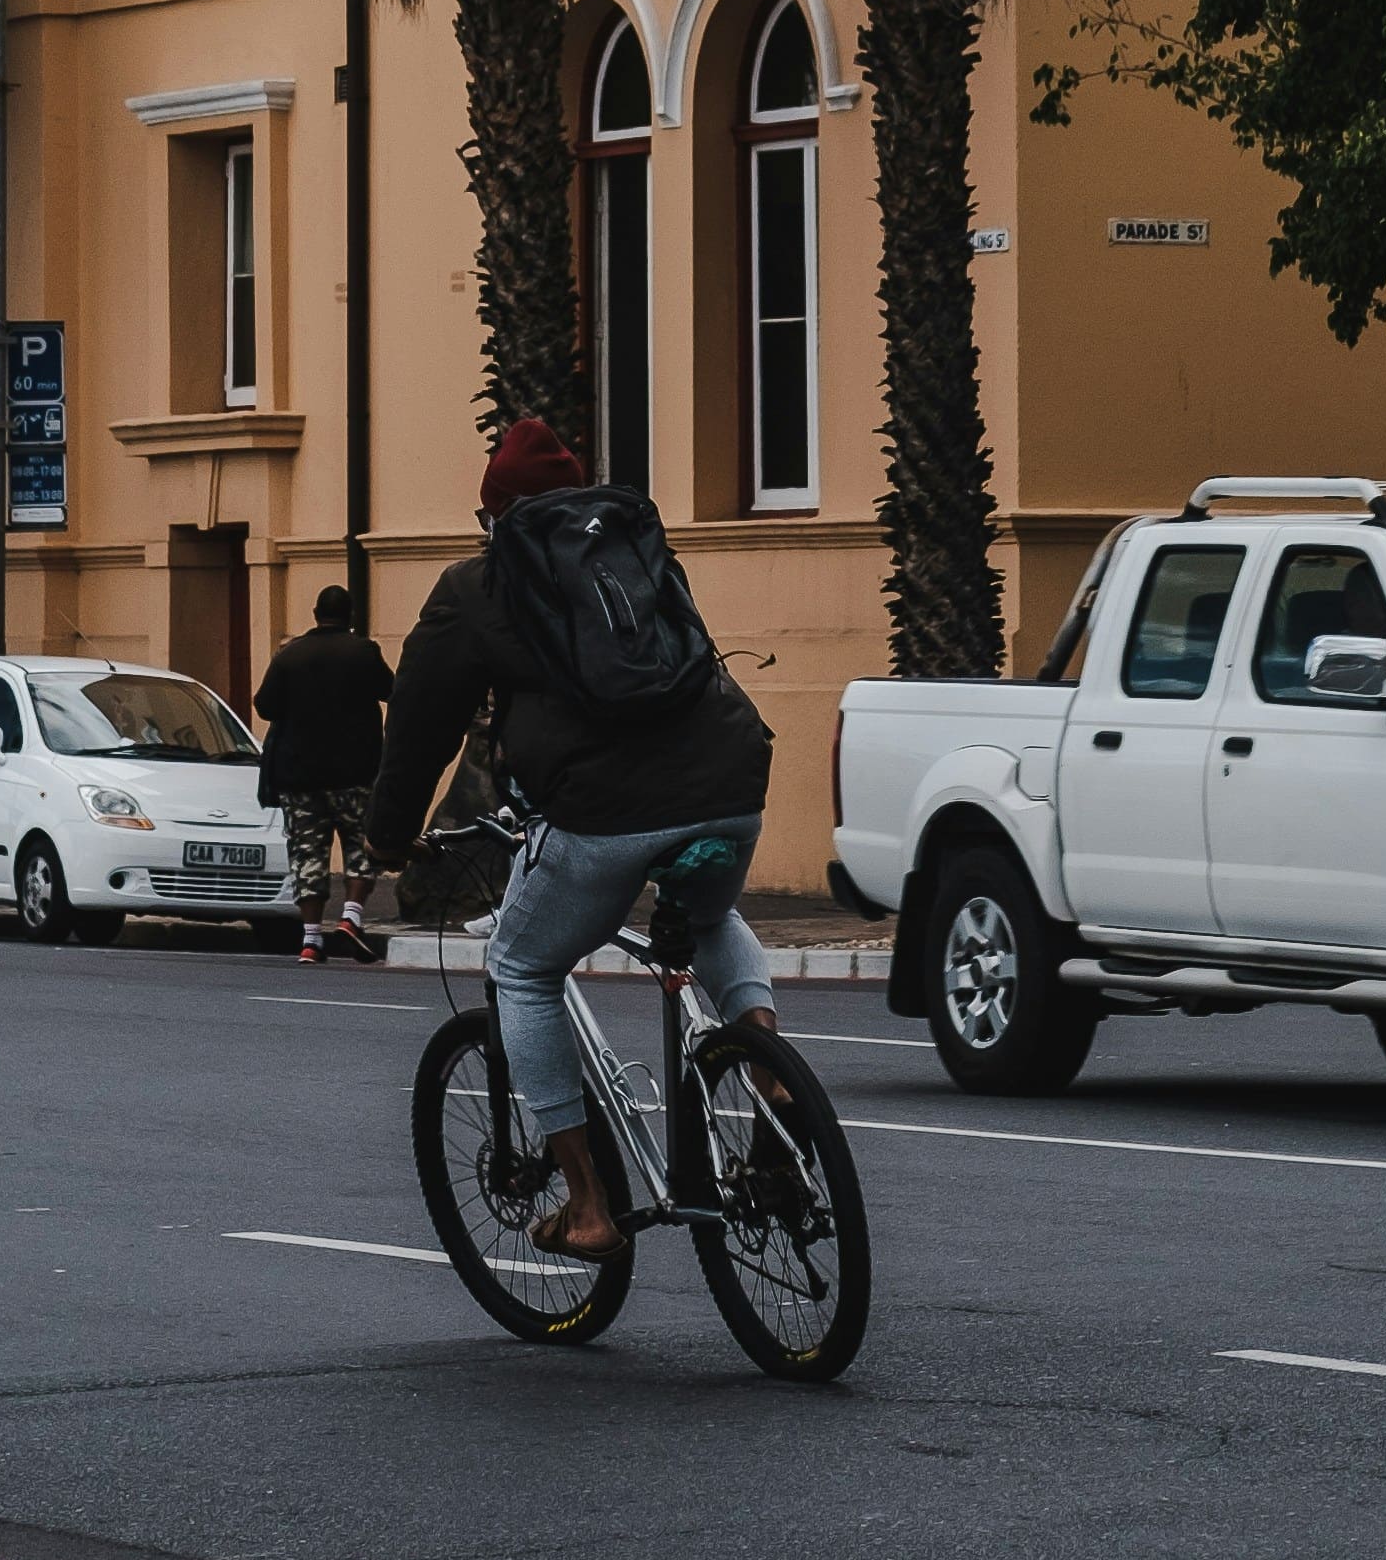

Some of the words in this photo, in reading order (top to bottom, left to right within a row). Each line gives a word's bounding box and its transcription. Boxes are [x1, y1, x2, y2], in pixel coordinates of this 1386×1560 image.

[1116, 223, 1180, 240] PARADE
[22, 336, 47, 367] P
[14, 376, 32, 390] 60
